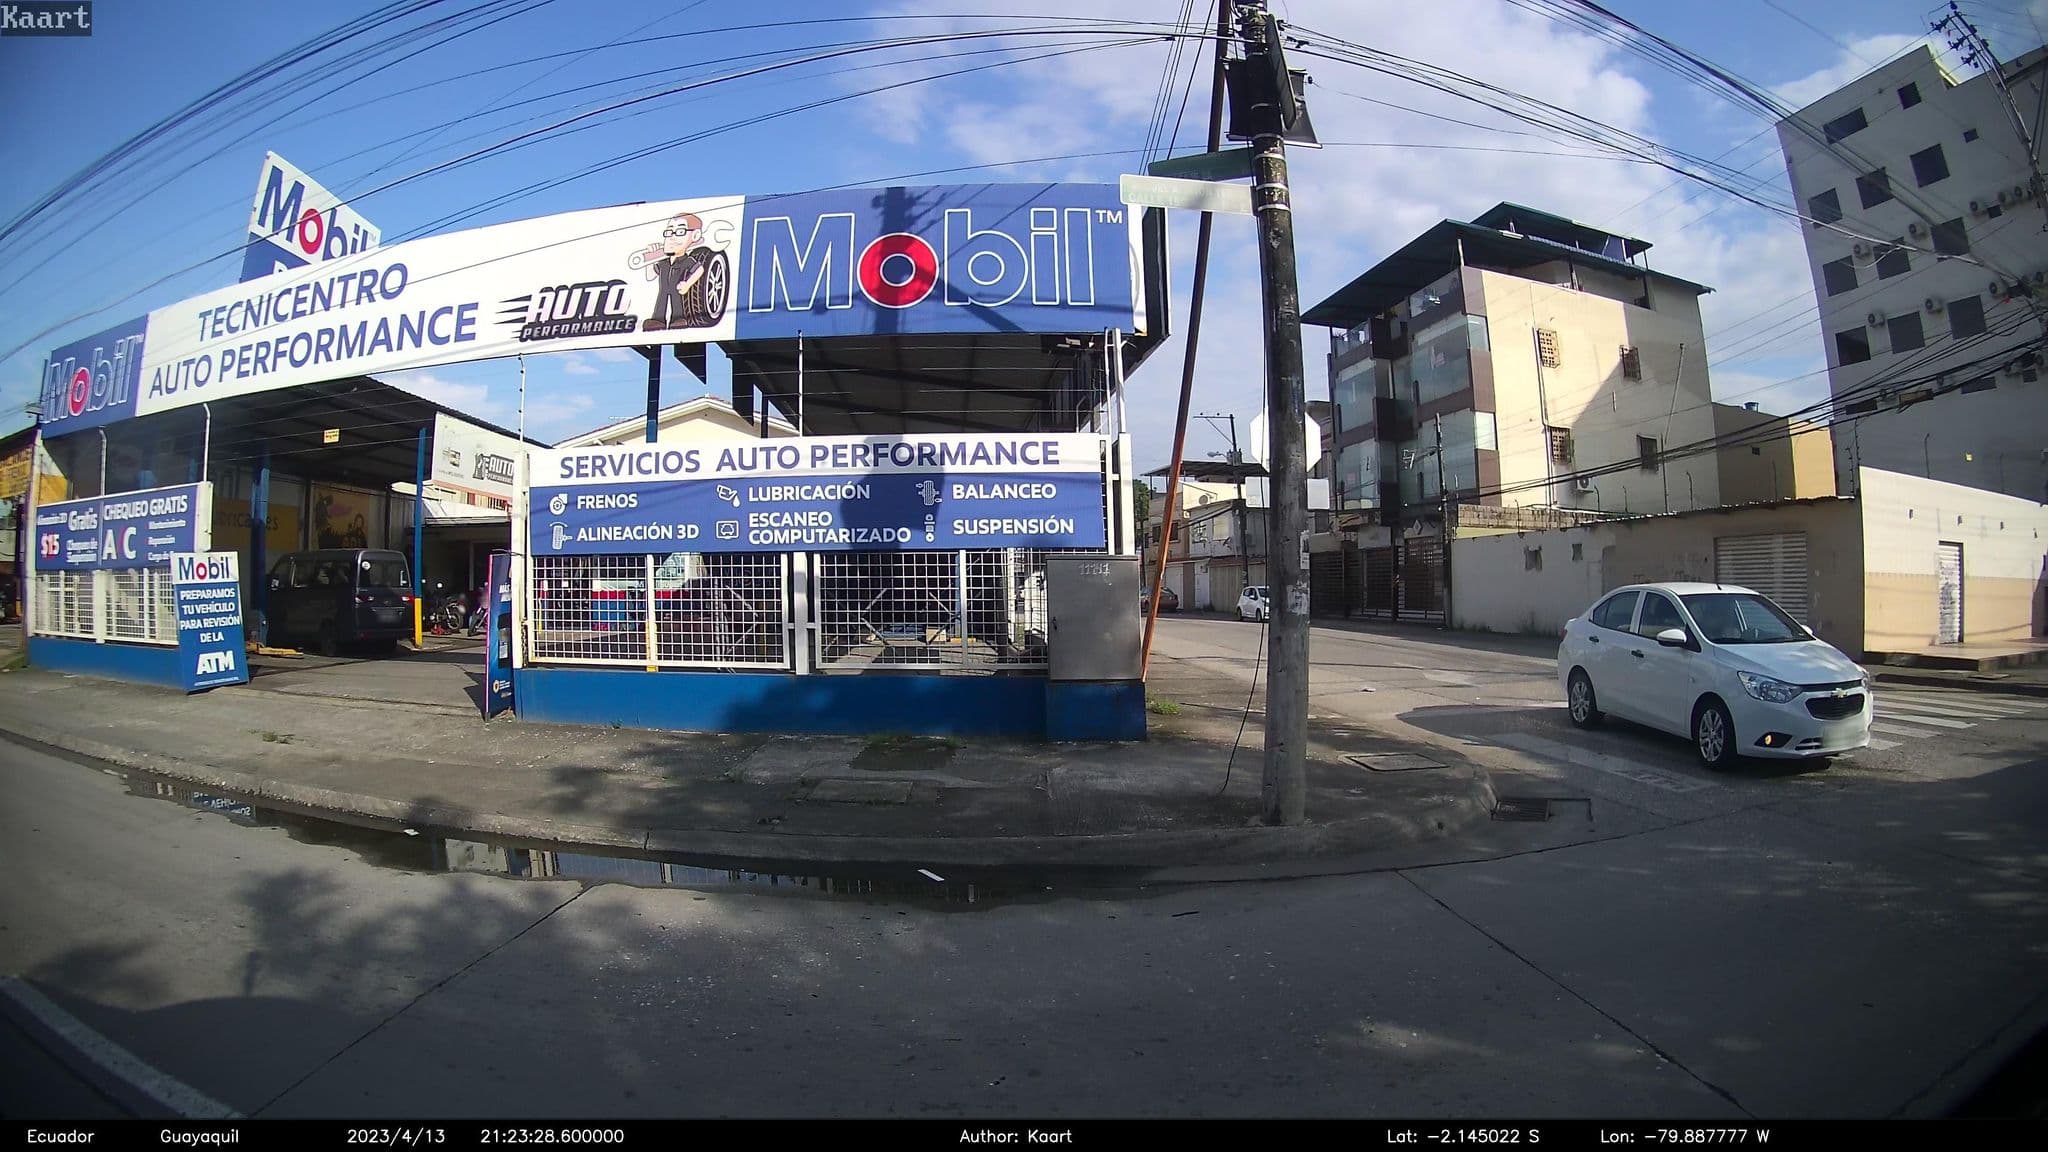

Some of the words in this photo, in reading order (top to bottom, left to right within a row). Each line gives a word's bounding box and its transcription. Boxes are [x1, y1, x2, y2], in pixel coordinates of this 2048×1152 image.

[258, 165, 369, 262] Mobil
[749, 208, 1096, 310] Mobil
[199, 263, 408, 342] TECNICENTRO
[526, 281, 632, 325] AUTO
[521, 317, 636, 340] PERFORMANCE
[149, 354, 212, 399] AUTO
[219, 302, 479, 383] PERFORMANCE
[39, 336, 136, 424] Mobil
[489, 456, 514, 477] AUTO
[560, 449, 700, 479] SERVICIOS
[716, 446, 806, 472] AUTO
[810, 441, 1060, 468] PERFORMANCE
[577, 493, 638, 509] FRENOS
[748, 481, 870, 502] LUBRICACIÓN
[952, 484, 1057, 500] BALANCEO
[68, 507, 98, 531] Gratis
[104, 500, 149, 521] CHEQUEO
[150, 495, 188, 517] GRATIS
[748, 511, 833, 528] ESCANEO
[953, 515, 1074, 535] SUSPENSIÓN
[576, 523, 674, 542] ALINEACIÓN
[677, 524, 700, 539] 3D
[748, 527, 911, 545] COMPUTARIZADO
[179, 557, 230, 581] Mobil
[180, 588, 235, 601] PREPARAMOS
[182, 605, 194, 615] TU
[195, 601, 235, 614] VEHÍCULO
[180, 619, 202, 630] PARA
[203, 614, 240, 628] REVISIÓN
[200, 632, 212, 643] DE
[213, 632, 224, 642] LA
[196, 651, 235, 675] ATM
